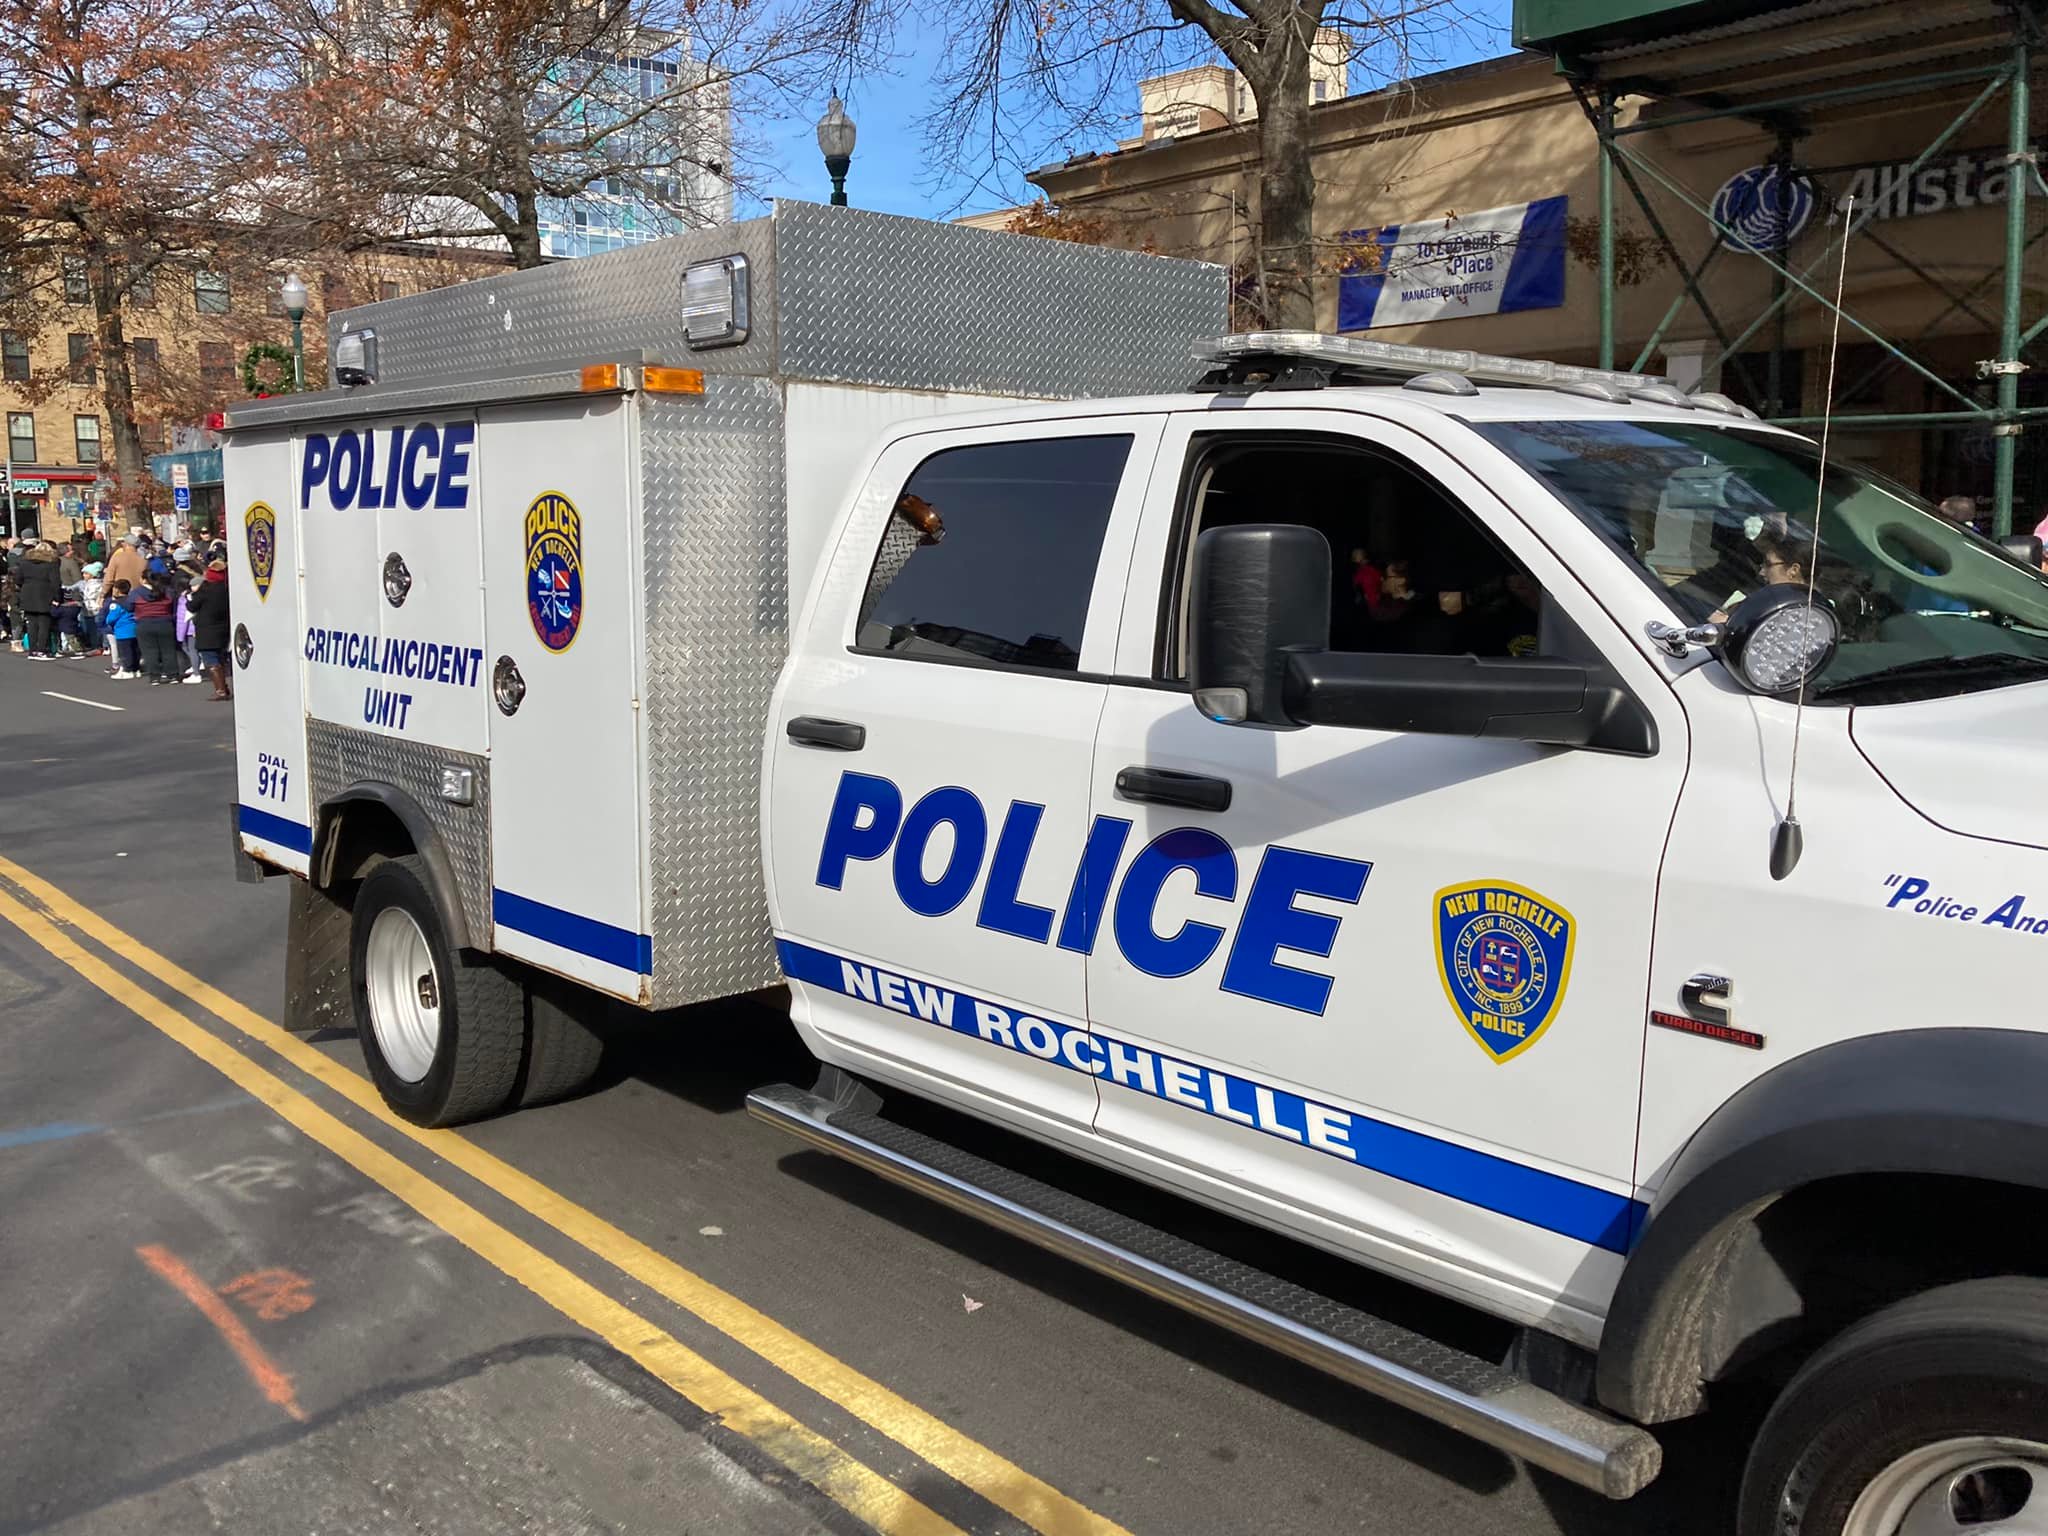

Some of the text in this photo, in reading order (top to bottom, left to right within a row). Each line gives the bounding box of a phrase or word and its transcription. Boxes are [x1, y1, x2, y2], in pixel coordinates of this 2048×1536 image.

[1453, 256, 1493, 274] Place
[1402, 284, 1461, 303] MANAGEMENT
[1463, 281, 1493, 295] OFFICE
[301, 422, 475, 511] POLICE
[527, 499, 578, 549] POLICE
[531, 539, 577, 574] NEW ROCHELLE
[305, 627, 483, 688] CRITICAL INCIDENT
[364, 687, 413, 730] UNIT
[258, 752, 288, 770] DIAL
[258, 766, 288, 802] 911
[815, 769, 1375, 1018] POLICE
[1445, 891, 1564, 939] NEW ROCHELLE
[1473, 917, 1495, 934] NEW
[1461, 931, 1473, 948] OF
[1458, 951, 1469, 978] CITY
[1474, 992, 1524, 1014] INC. 1899
[1472, 1011, 1525, 1038] POLICE
[1654, 1012, 1760, 1046] TURBO DIESEL
[839, 960, 1358, 1160] NEW ROCHELLE
